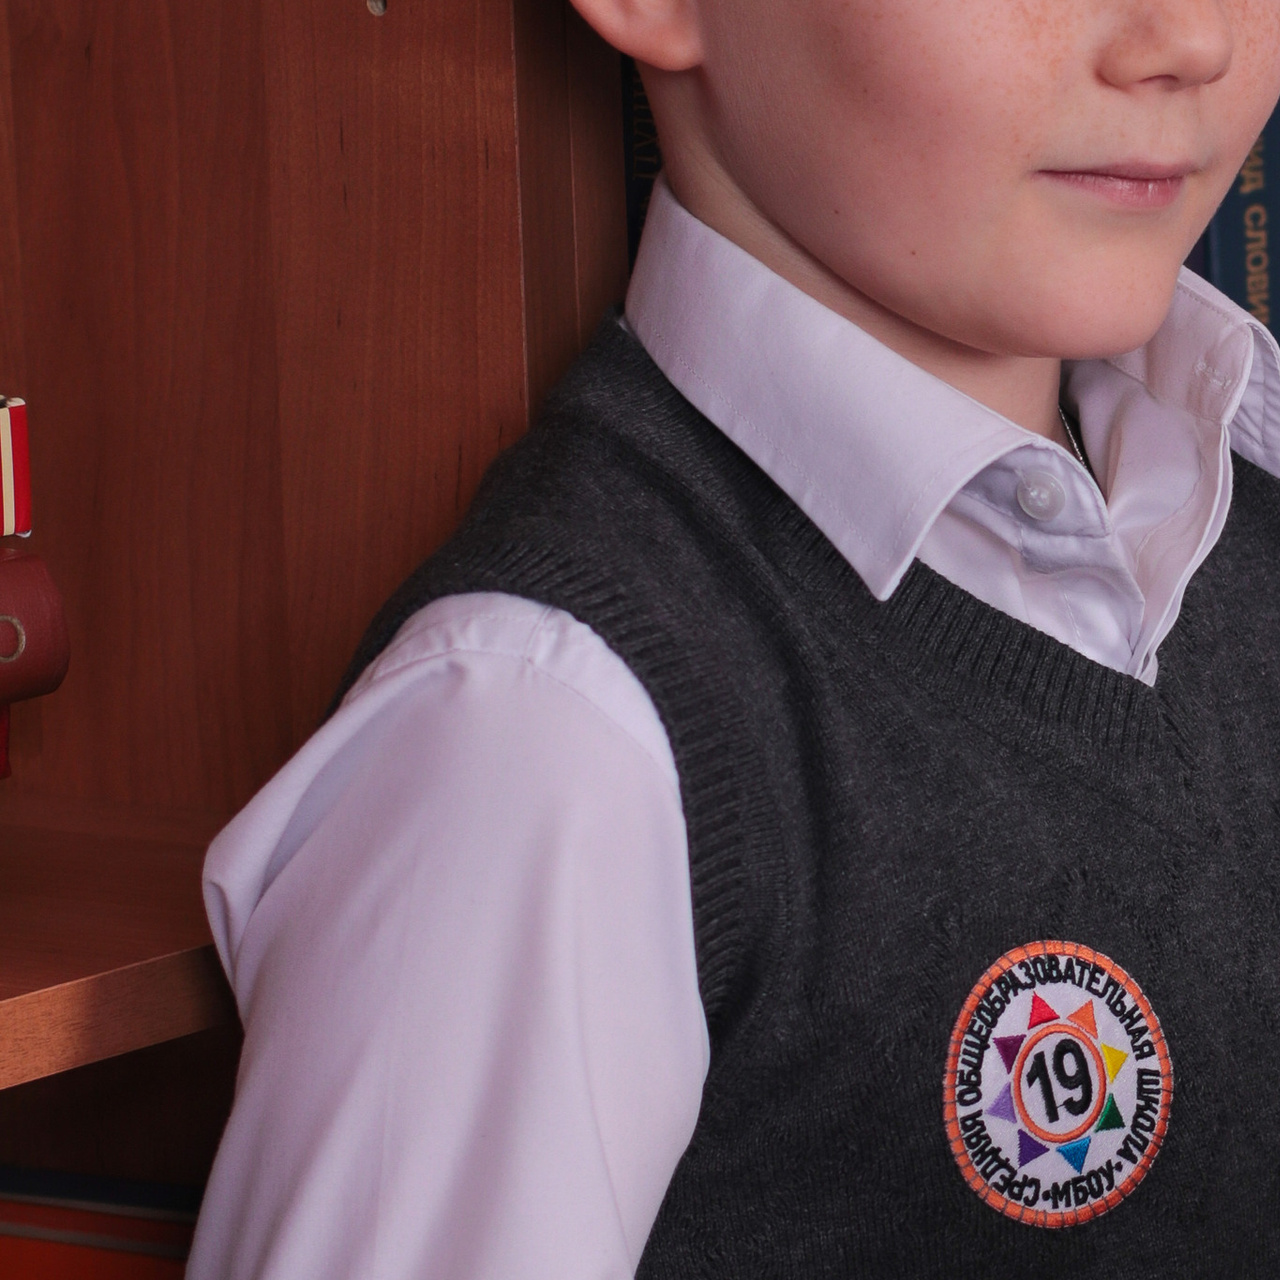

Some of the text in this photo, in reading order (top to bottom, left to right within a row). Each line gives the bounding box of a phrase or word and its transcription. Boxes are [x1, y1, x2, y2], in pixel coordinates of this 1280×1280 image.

[956, 954, 1162, 1208] СРЕДНЯЯ ОБЩЕОБРАЗОВАТЕЛЬНАЯ ШКОЛА
[1025, 1038, 1094, 1124] 19
[1049, 1158, 1116, 1210] МБОУ
